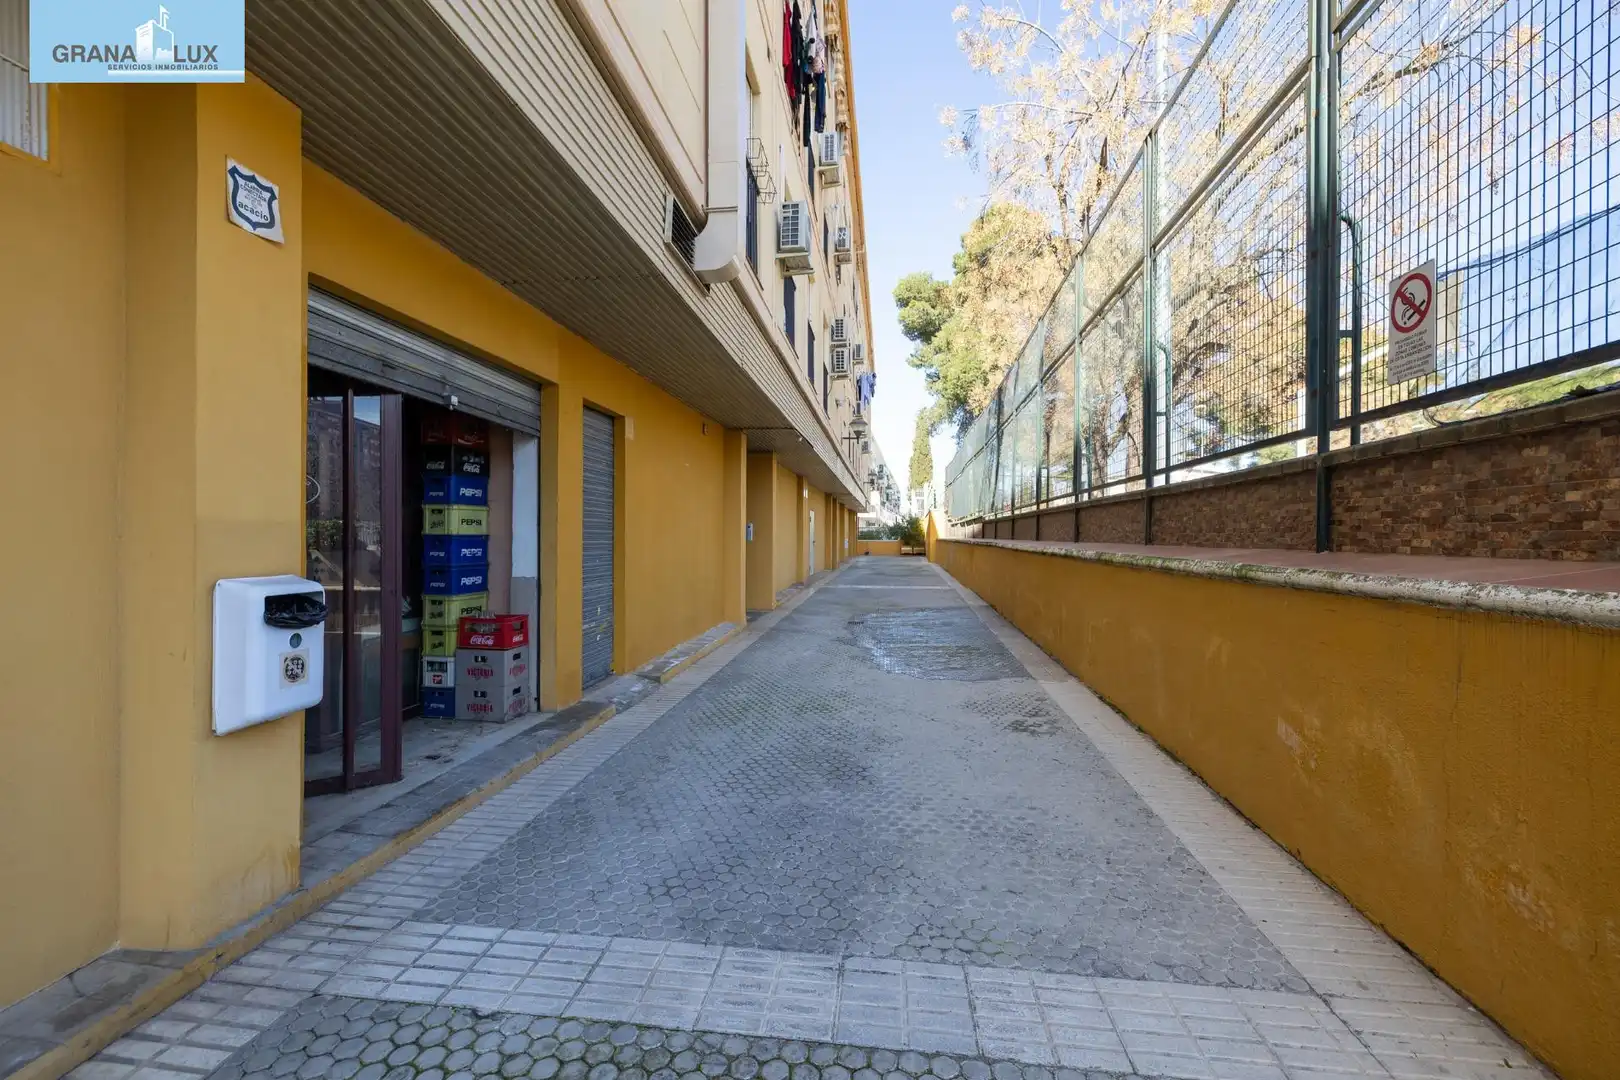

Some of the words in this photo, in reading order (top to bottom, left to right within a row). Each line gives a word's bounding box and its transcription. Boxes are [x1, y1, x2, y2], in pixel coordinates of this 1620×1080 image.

[238, 201, 269, 221] acacio
[460, 488, 482, 498] PEPSI
[461, 518, 482, 526] PEPSI
[460, 548, 483, 557] PEPSI
[460, 576, 483, 586] PEPSI
[467, 668, 494, 678] VICTORIA
